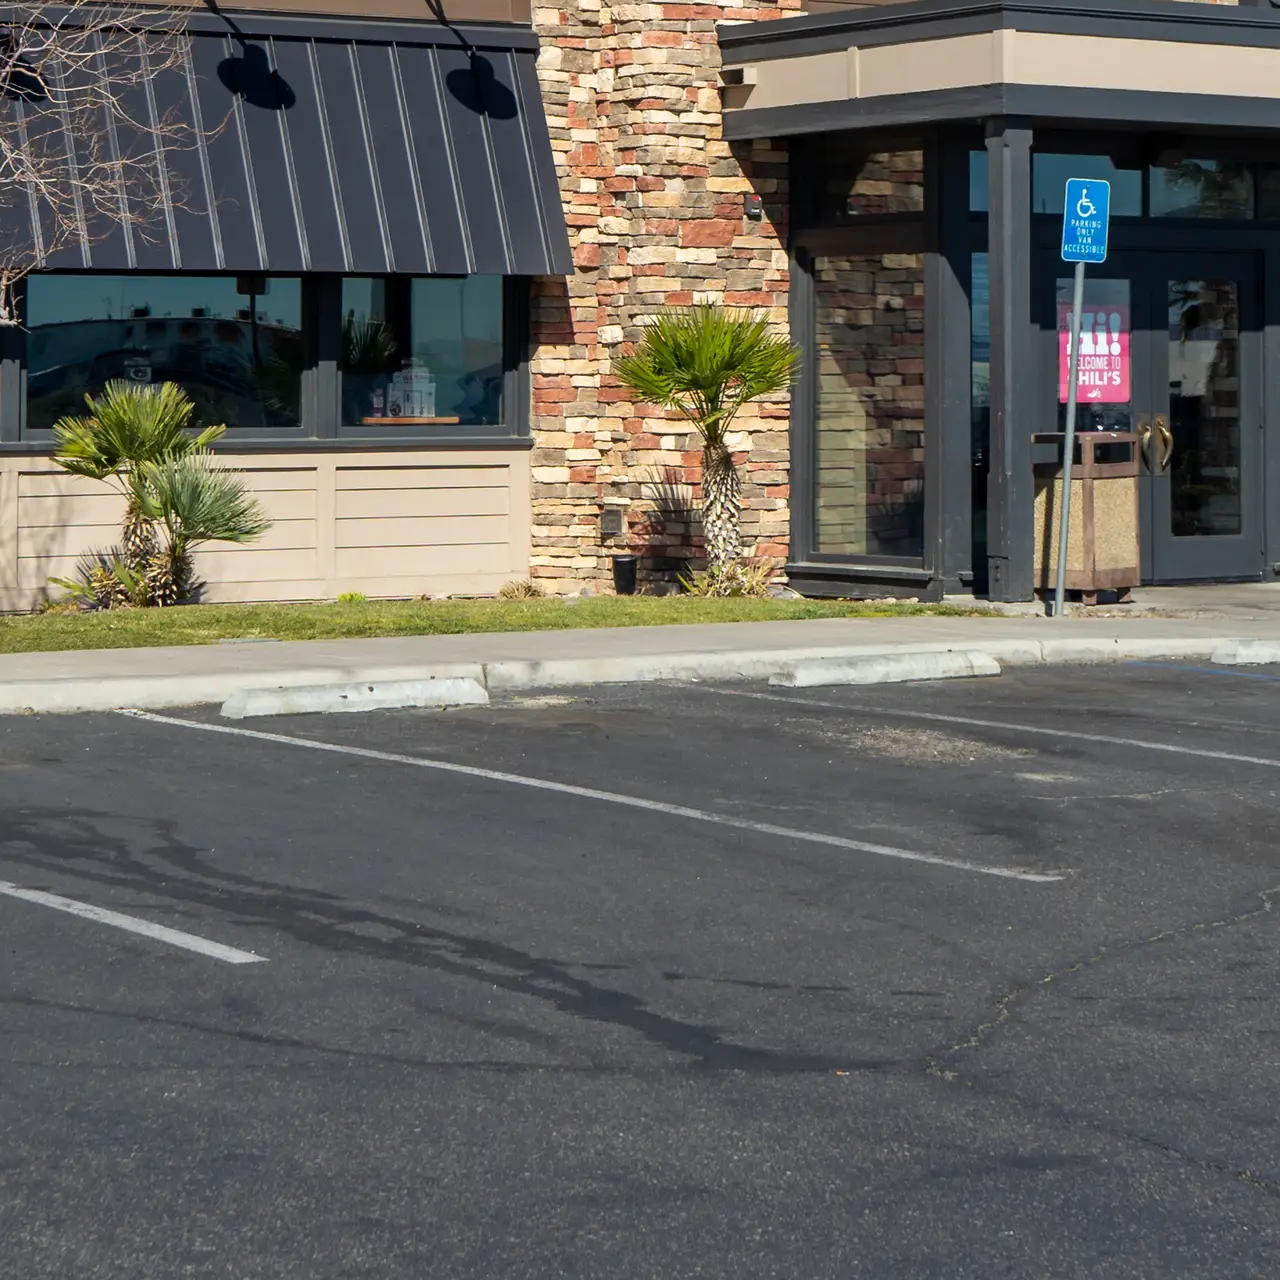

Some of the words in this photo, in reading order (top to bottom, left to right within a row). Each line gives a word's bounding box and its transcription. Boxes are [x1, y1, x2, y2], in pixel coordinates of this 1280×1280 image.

[1071, 219, 1102, 229] PARKING
[1076, 228, 1095, 236] ONLY
[1078, 236, 1092, 244] VAN
[1064, 244, 1105, 254] ACCESSIBLE
[1111, 356, 1121, 370] TO
